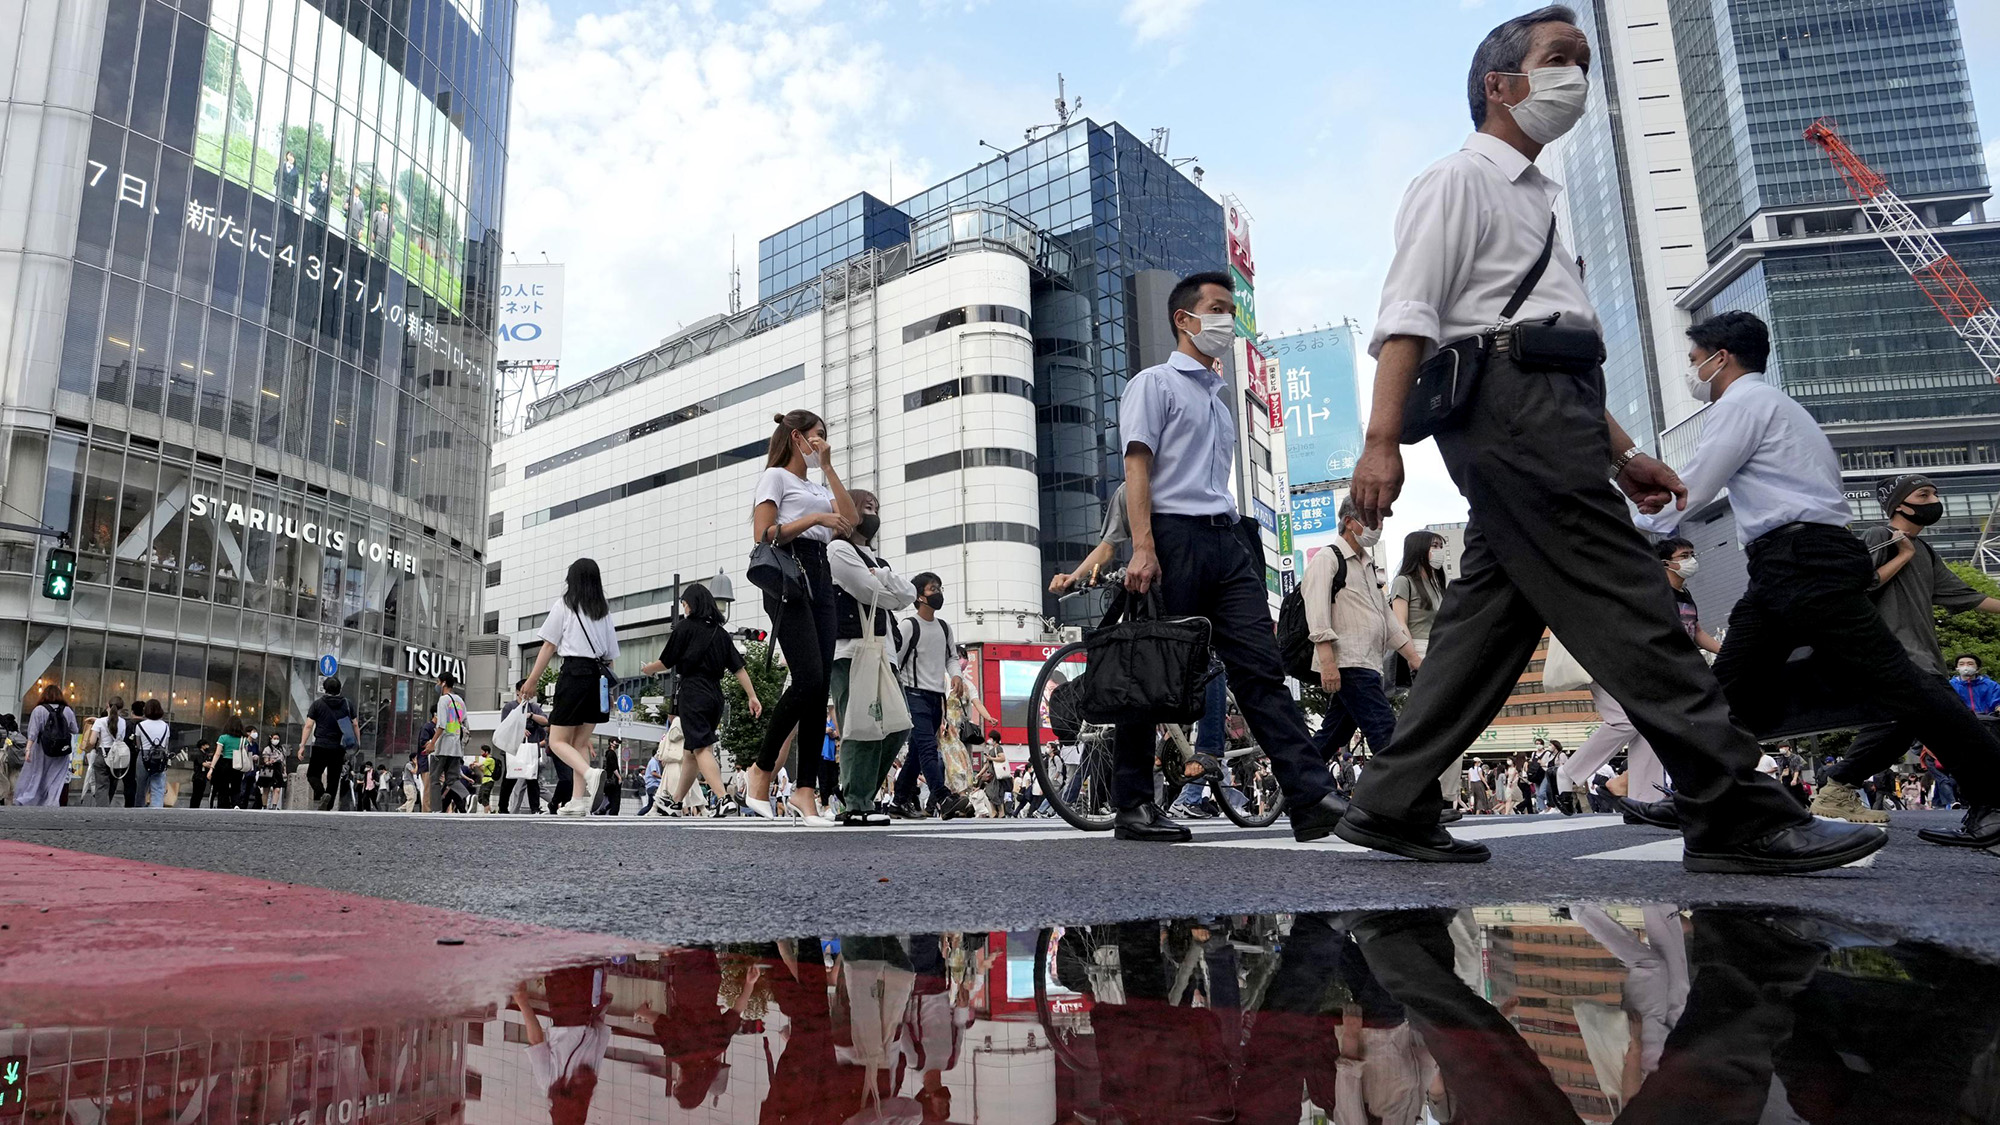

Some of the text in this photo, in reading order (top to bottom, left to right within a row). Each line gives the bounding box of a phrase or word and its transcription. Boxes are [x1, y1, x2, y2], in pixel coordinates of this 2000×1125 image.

[1286, 366, 1312, 401] 散
[1271, 402, 1282, 427] アイフル
[189, 493, 345, 551] STARBUCKS
[1480, 730, 1498, 741] JR
